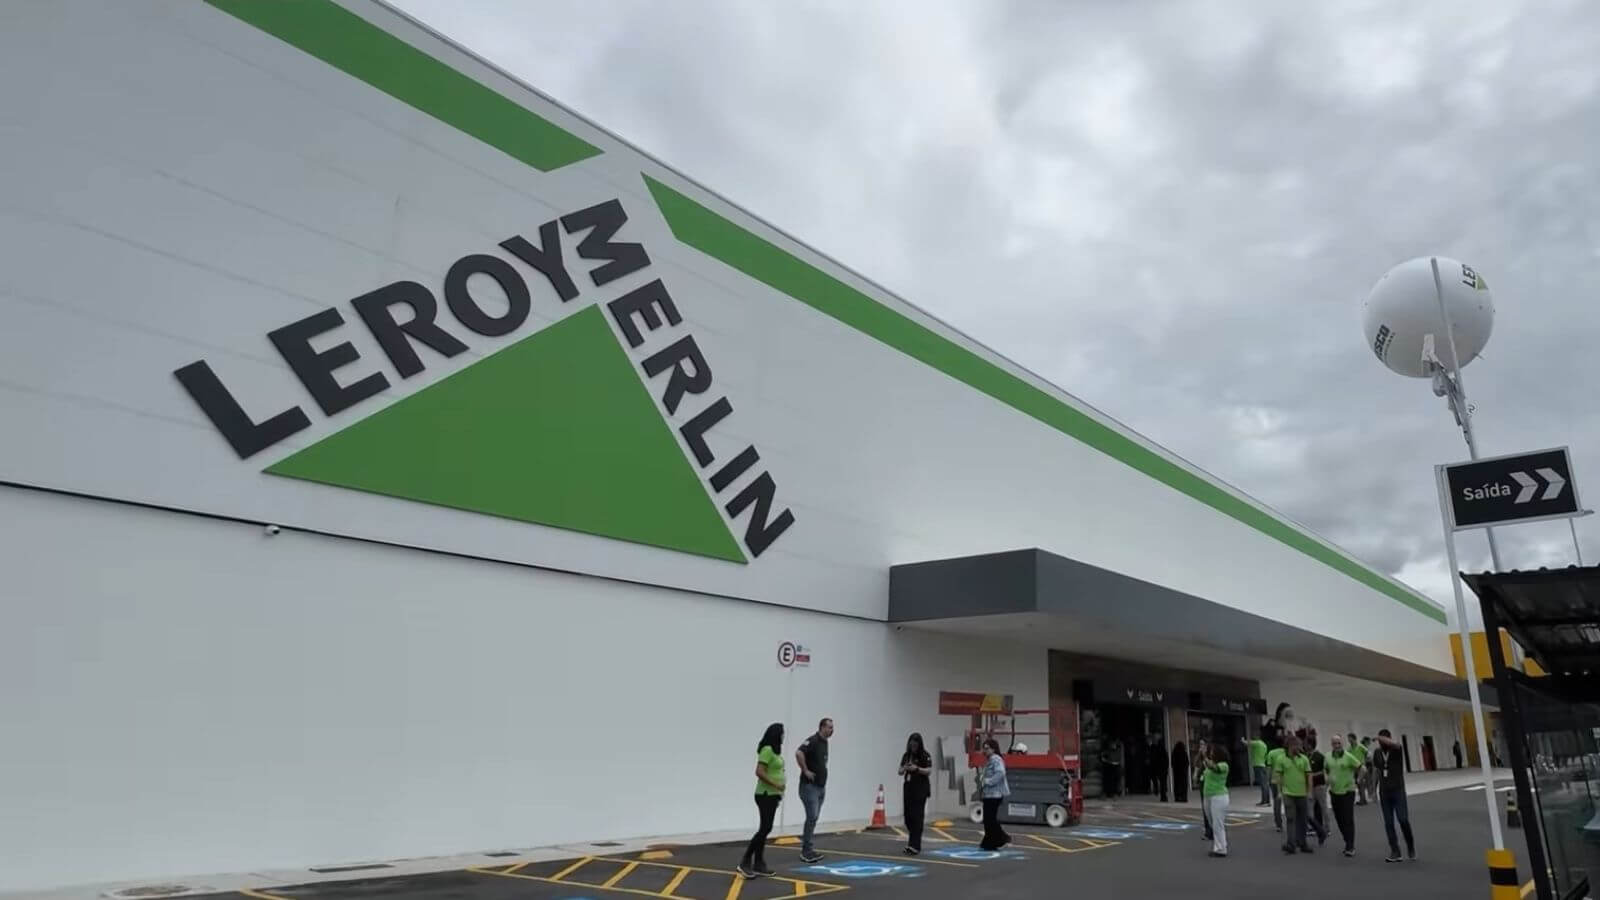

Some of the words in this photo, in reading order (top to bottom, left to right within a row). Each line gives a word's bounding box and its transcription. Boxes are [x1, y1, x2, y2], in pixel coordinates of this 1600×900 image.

[173, 218, 580, 461] LEROY
[559, 198, 796, 559] MERLIN
[1463, 482, 1511, 501] Saída
[783, 647, 791, 662] E
